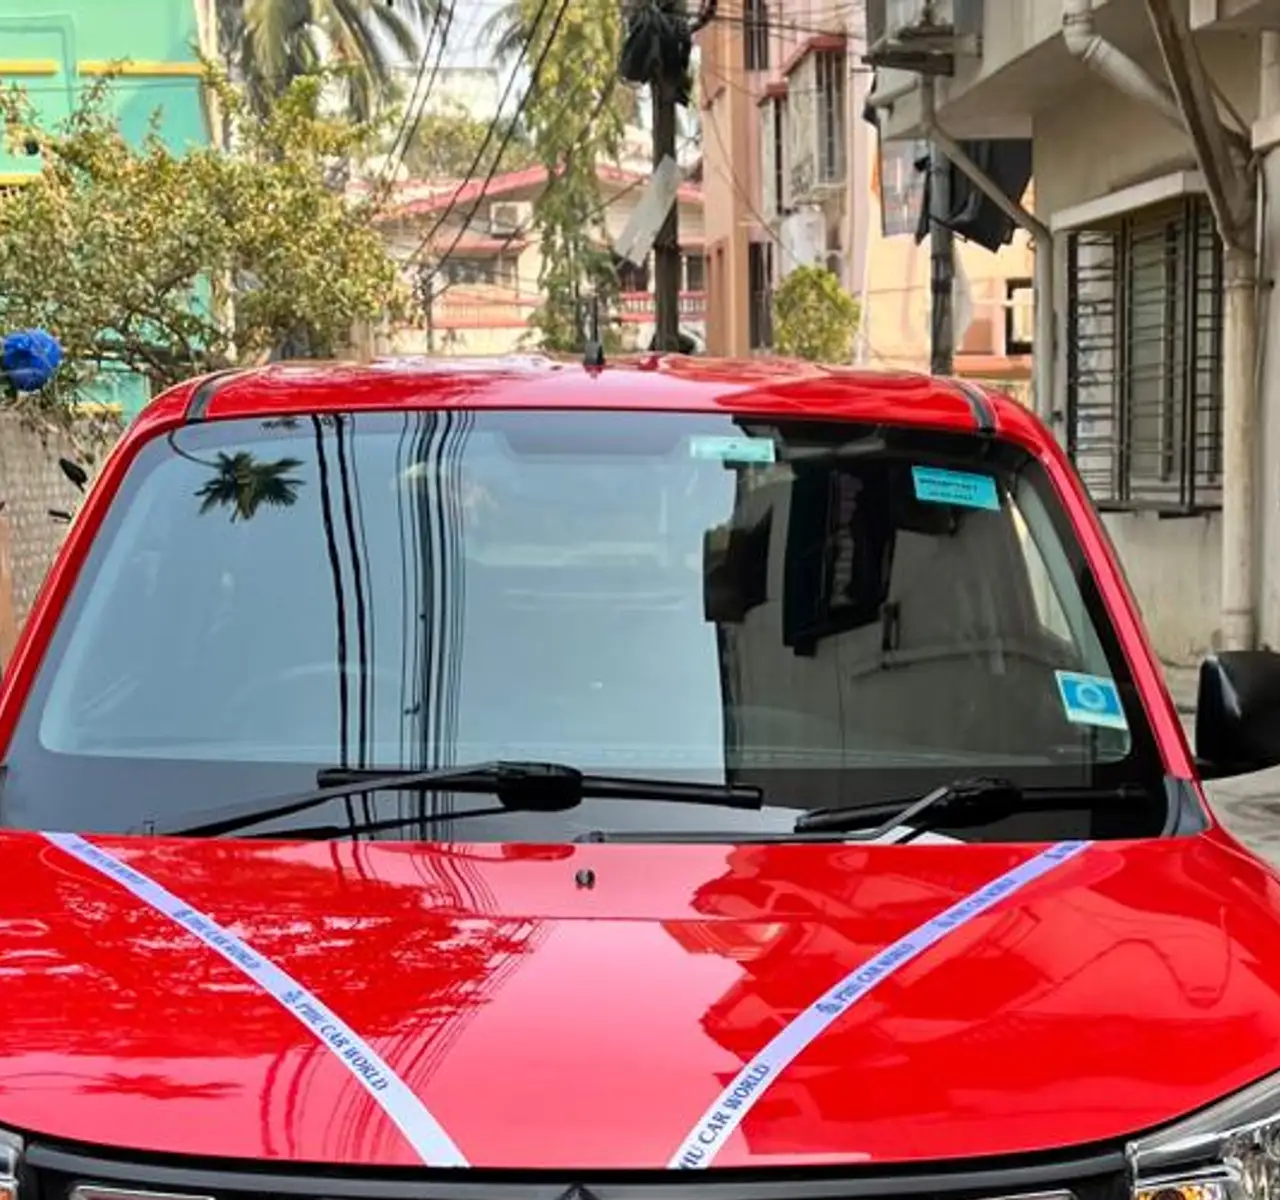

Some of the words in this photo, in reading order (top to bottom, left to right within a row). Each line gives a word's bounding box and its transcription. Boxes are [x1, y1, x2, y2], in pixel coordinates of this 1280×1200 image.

[321, 1025, 350, 1048] CAR
[344, 1047, 388, 1091] WORLD
[698, 1111, 731, 1144] CAR
[722, 1062, 770, 1110] WORLD
